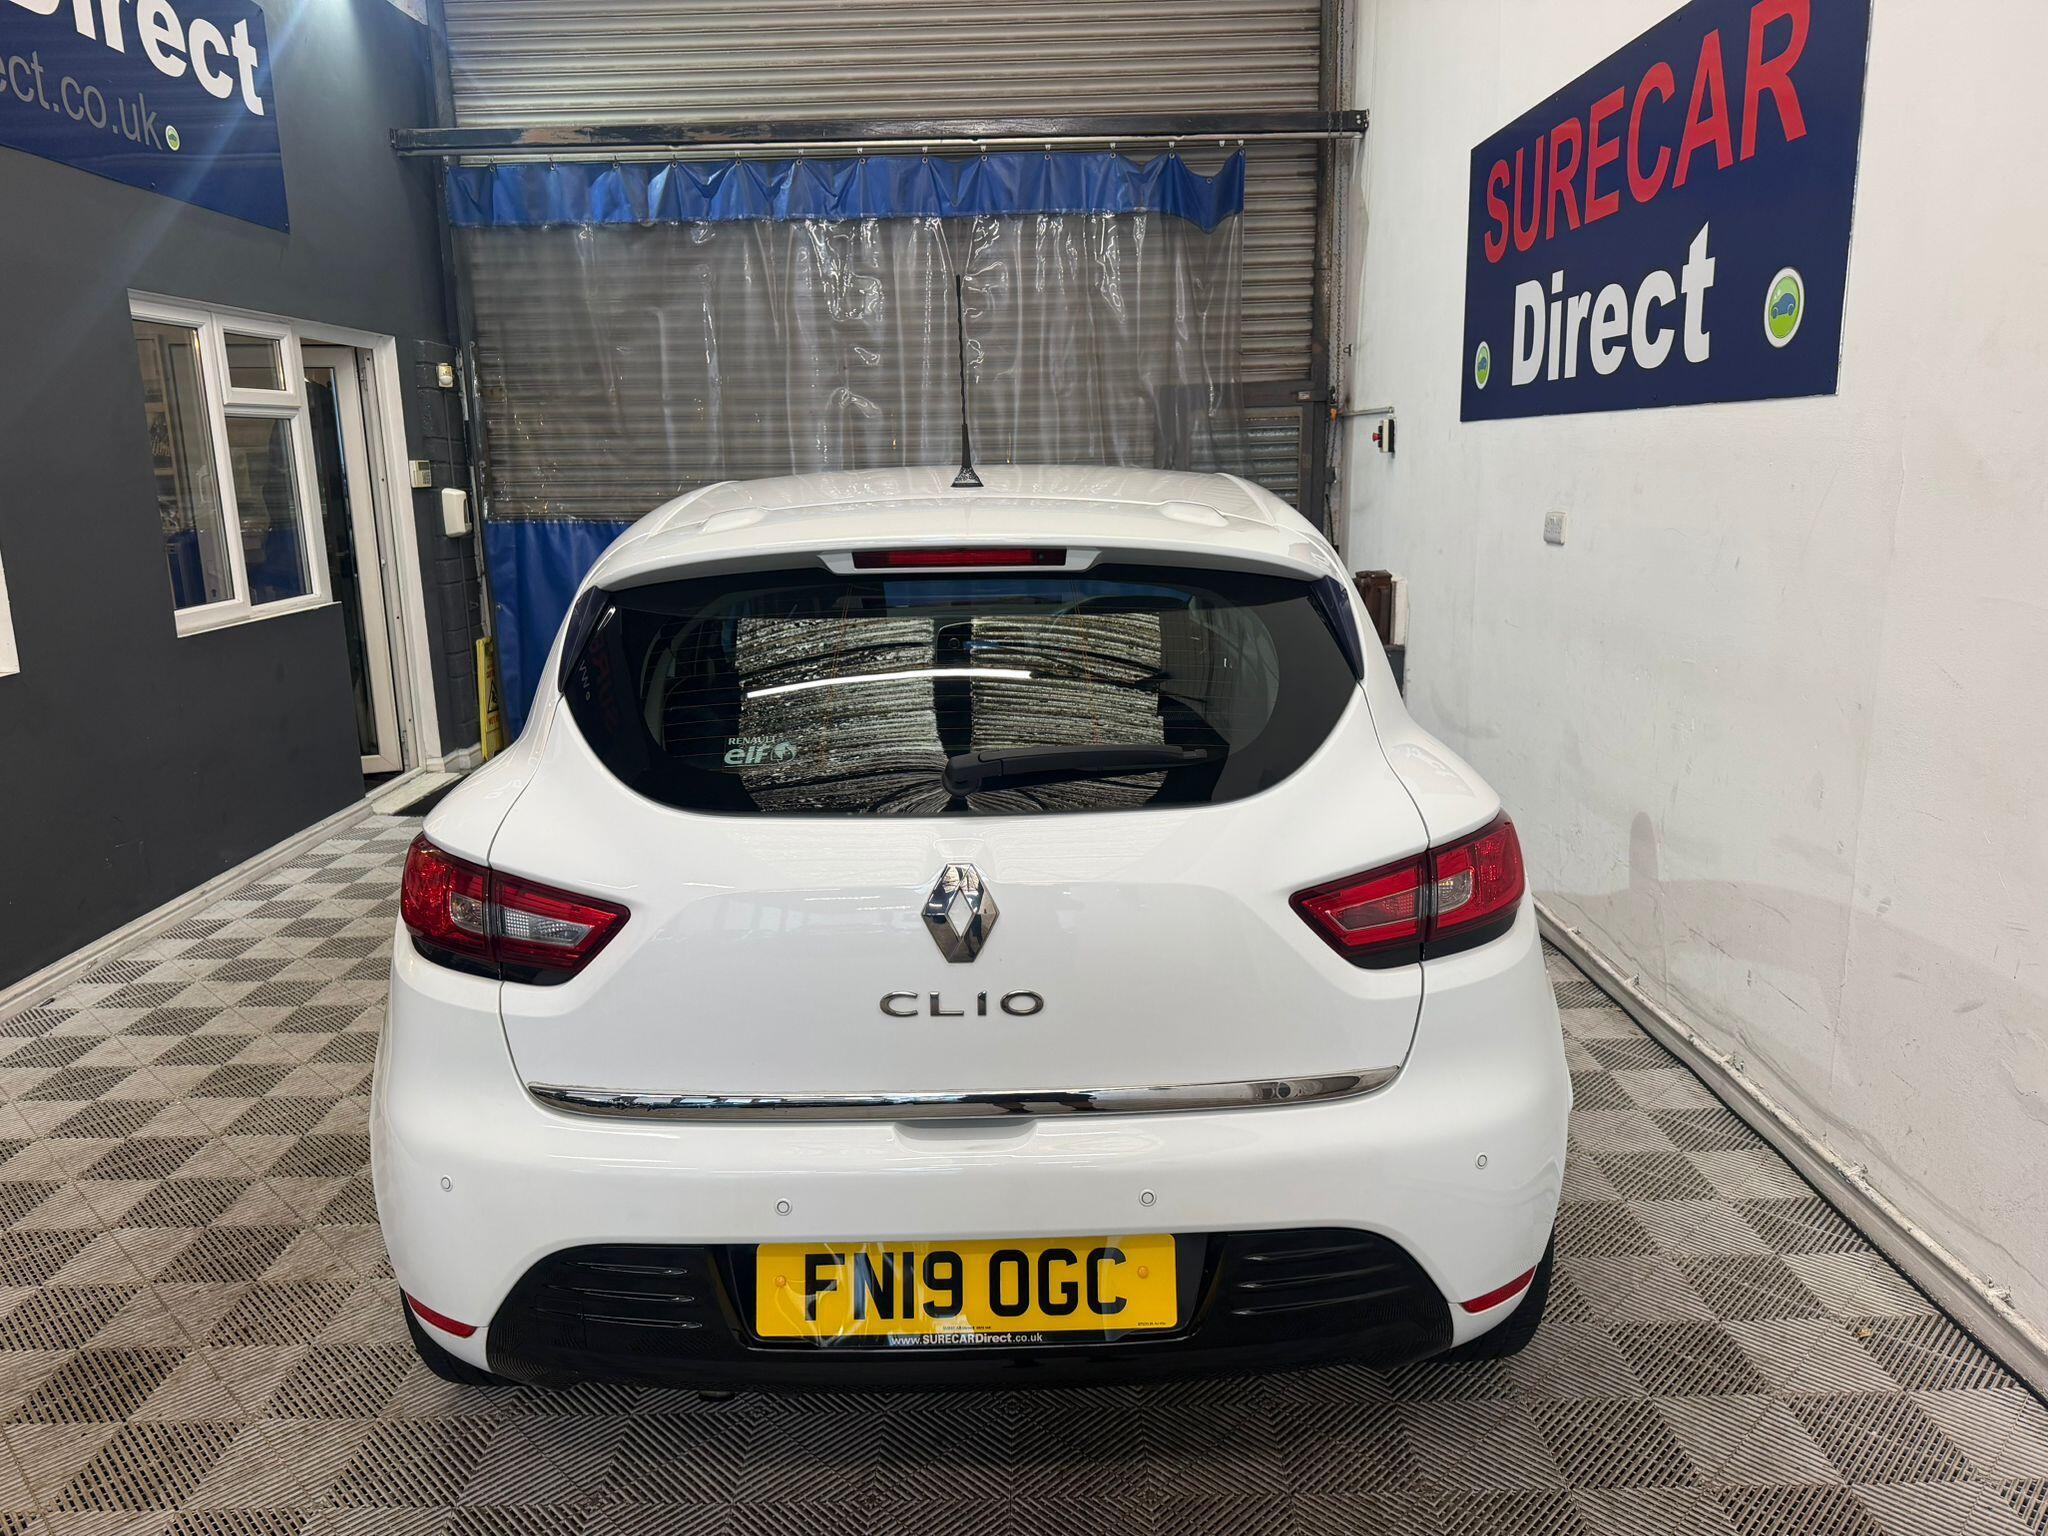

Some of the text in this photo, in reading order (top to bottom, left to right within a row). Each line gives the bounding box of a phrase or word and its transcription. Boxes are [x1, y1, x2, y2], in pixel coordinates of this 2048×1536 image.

[9, 0, 264, 116] irect
[1484, 0, 1811, 264] SURECAR
[1511, 221, 1716, 387] Direct
[723, 744, 771, 765] elf
[728, 735, 776, 746] RENAULT
[879, 989, 1044, 1018] CLIO
[804, 1247, 1127, 1321] FN19 OGC
[891, 1332, 1043, 1345] www.SURECARDirect.co.uk
